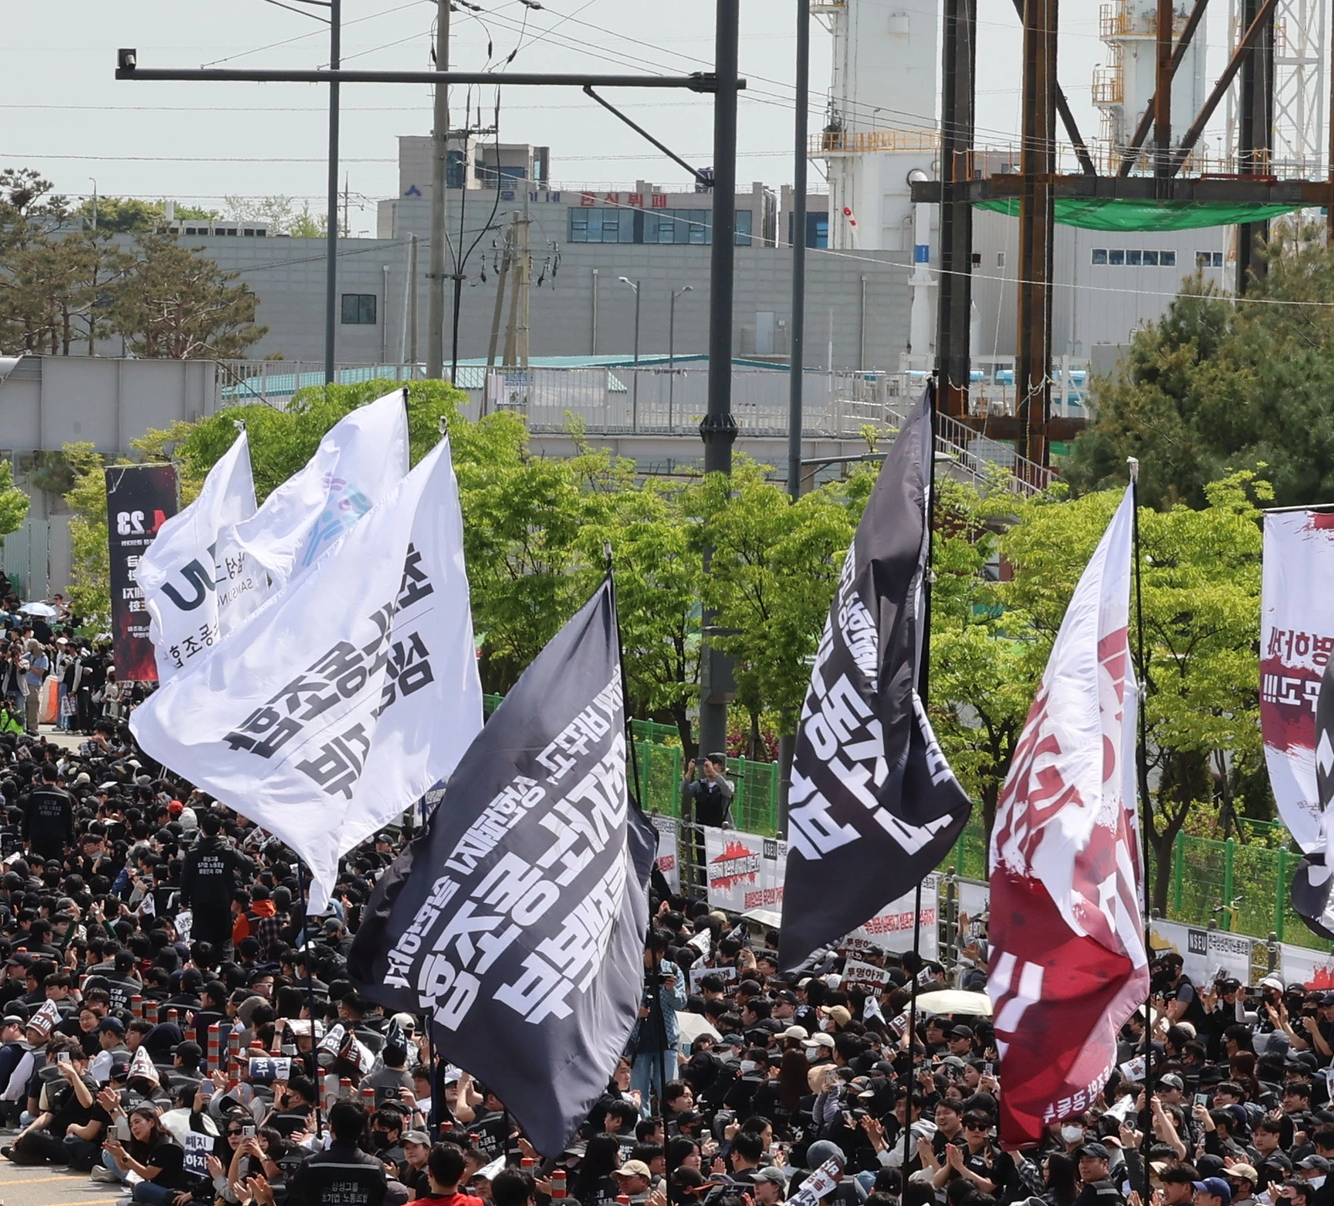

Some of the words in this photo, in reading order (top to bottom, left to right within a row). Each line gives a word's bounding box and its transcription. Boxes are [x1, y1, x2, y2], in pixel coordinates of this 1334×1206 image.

[580, 192, 668, 208] 한식뷔페
[1189, 934, 1207, 951] NSEU
[846, 967, 885, 981] 투명하게
